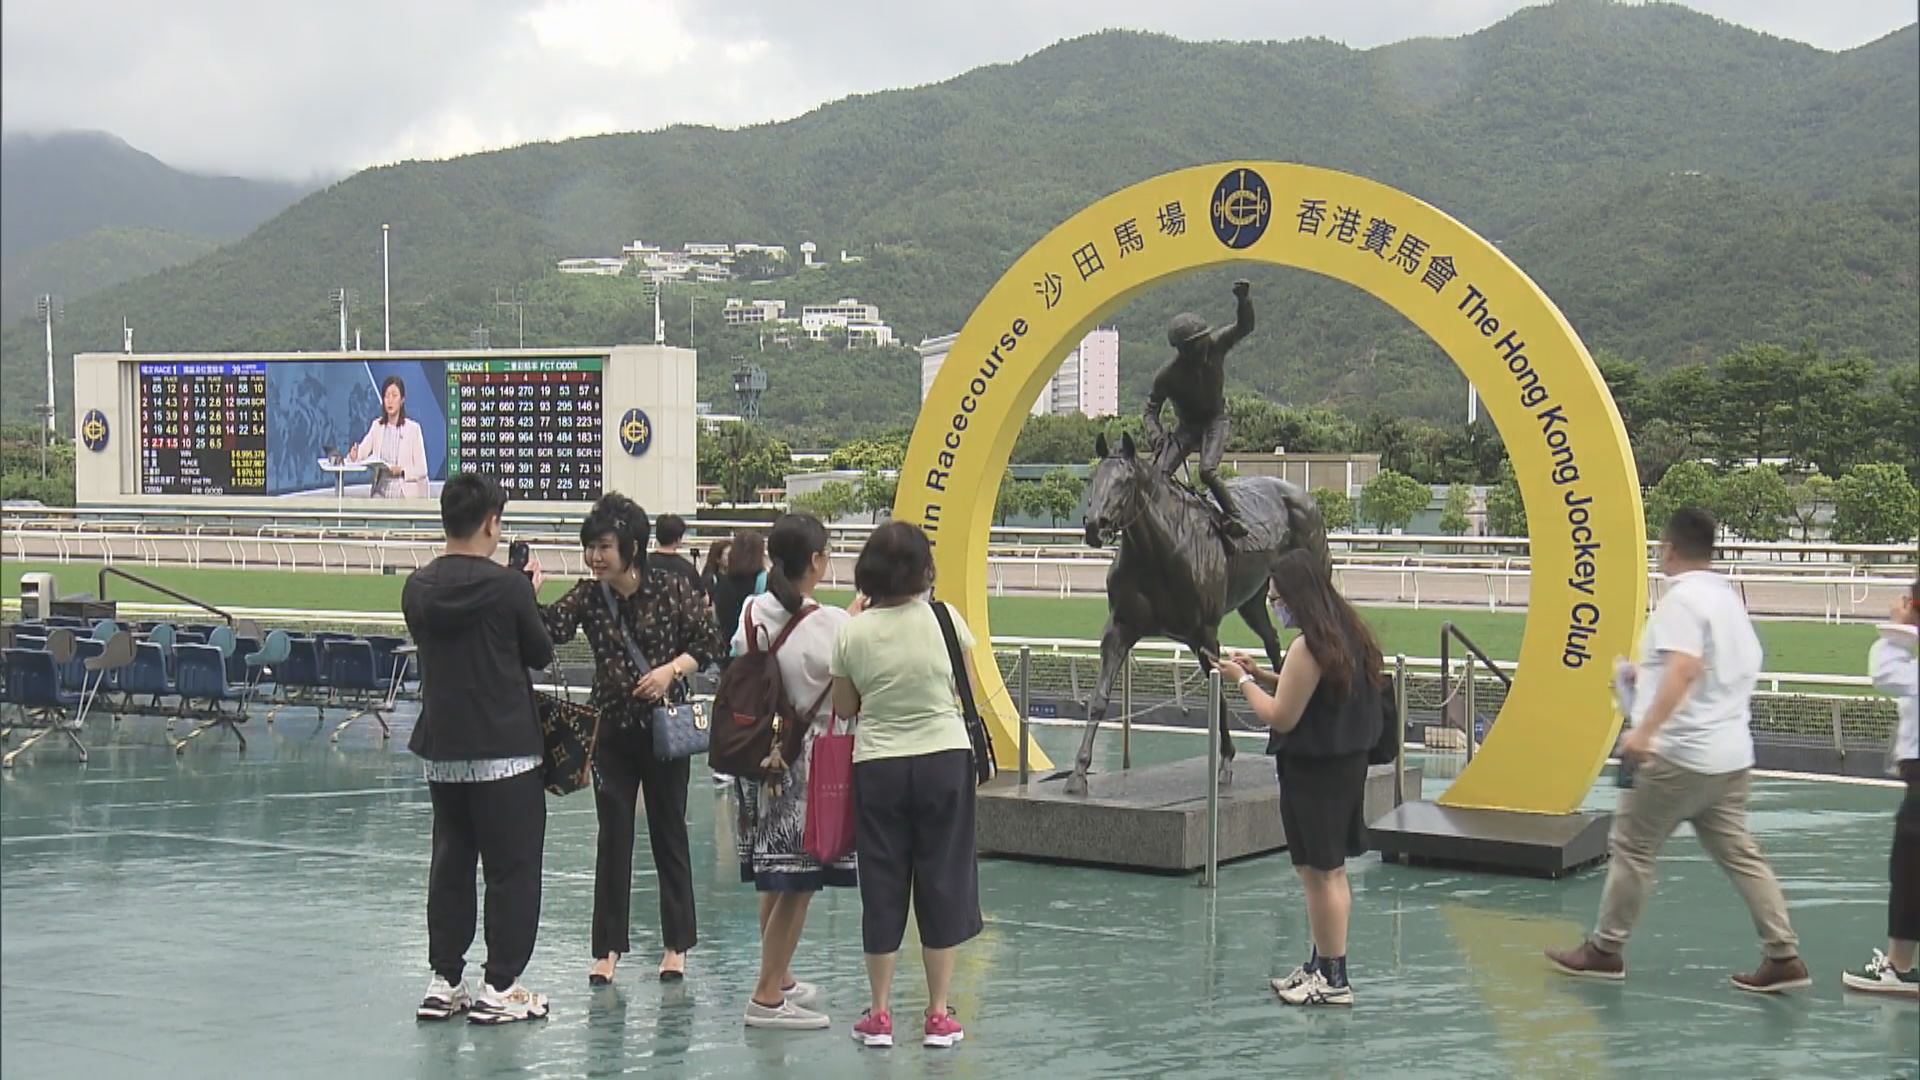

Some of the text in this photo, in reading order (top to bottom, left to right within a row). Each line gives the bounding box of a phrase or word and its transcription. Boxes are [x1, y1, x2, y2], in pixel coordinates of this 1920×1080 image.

[1296, 198, 1458, 294] 香港賽馬會
[1033, 200, 1186, 310] 沙田馬場
[172, 365, 177, 374] 1
[462, 362, 484, 371] RACE
[485, 362, 489, 371] 1
[540, 362, 555, 370] FCT
[556, 362, 577, 370] ODDS
[143, 384, 147, 393] 1
[168, 384, 176, 393] 12
[183, 384, 188, 393] 6
[210, 384, 220, 393] 1.7
[226, 384, 233, 393] 11
[254, 383, 263, 393] 10
[461, 386, 475, 396] 991
[481, 386, 494, 396] 104
[500, 386, 514, 396] 149
[518, 386, 533, 396] 270
[541, 386, 550, 396] 19
[560, 386, 569, 395] 53
[579, 385, 589, 395] 57
[143, 397, 147, 407] 2
[154, 398, 161, 406] 14
[166, 398, 177, 407] 4.3
[184, 397, 188, 407] 7
[226, 397, 234, 407] 12
[462, 402, 476, 411] 999
[480, 402, 495, 411] 347
[518, 401, 533, 411] 723
[540, 401, 550, 411] 93
[557, 401, 572, 411] 295
[143, 411, 148, 421] 3
[154, 411, 162, 420] 15
[184, 411, 188, 420] 8
[226, 411, 234, 421] 13
[240, 411, 247, 420] 11
[253, 411, 263, 421] 3.1
[480, 417, 495, 426] 307
[500, 416, 514, 426] 735
[518, 416, 533, 427] 423
[540, 416, 550, 426] 77
[558, 416, 572, 427] 183
[577, 416, 592, 426] 223
[143, 425, 148, 433] 4
[154, 425, 162, 434] 19
[184, 424, 188, 434] 9
[196, 425, 205, 434] 45
[226, 425, 234, 434] 14
[239, 425, 248, 434] 22
[253, 425, 264, 435] 5.4
[919, 318, 1028, 547] in Racecourse
[462, 432, 476, 442] 999
[481, 432, 495, 442] 510
[499, 432, 514, 442] 999
[539, 432, 553, 442] 119
[578, 432, 592, 442] 183
[144, 438, 148, 447] 5
[152, 438, 163, 448] 2.7
[167, 438, 178, 448] 1.5
[183, 438, 190, 448] 10
[196, 438, 205, 448] 25
[462, 448, 476, 456] SCR
[481, 448, 495, 456] SCR
[500, 448, 514, 456] SCR
[519, 448, 533, 456] SCR
[538, 448, 553, 457] SCR
[557, 448, 572, 457] SCR
[577, 448, 592, 457] SCR
[462, 462, 476, 472] 999
[482, 462, 494, 472] 171
[500, 463, 514, 472] 199
[519, 462, 532, 473] 391
[540, 463, 550, 473] 28
[560, 463, 569, 473] 74
[580, 464, 589, 473] 73
[1457, 284, 1600, 669] The Hong Kong Jockey Club
[557, 479, 572, 489] 225
[579, 479, 589, 489] 92
